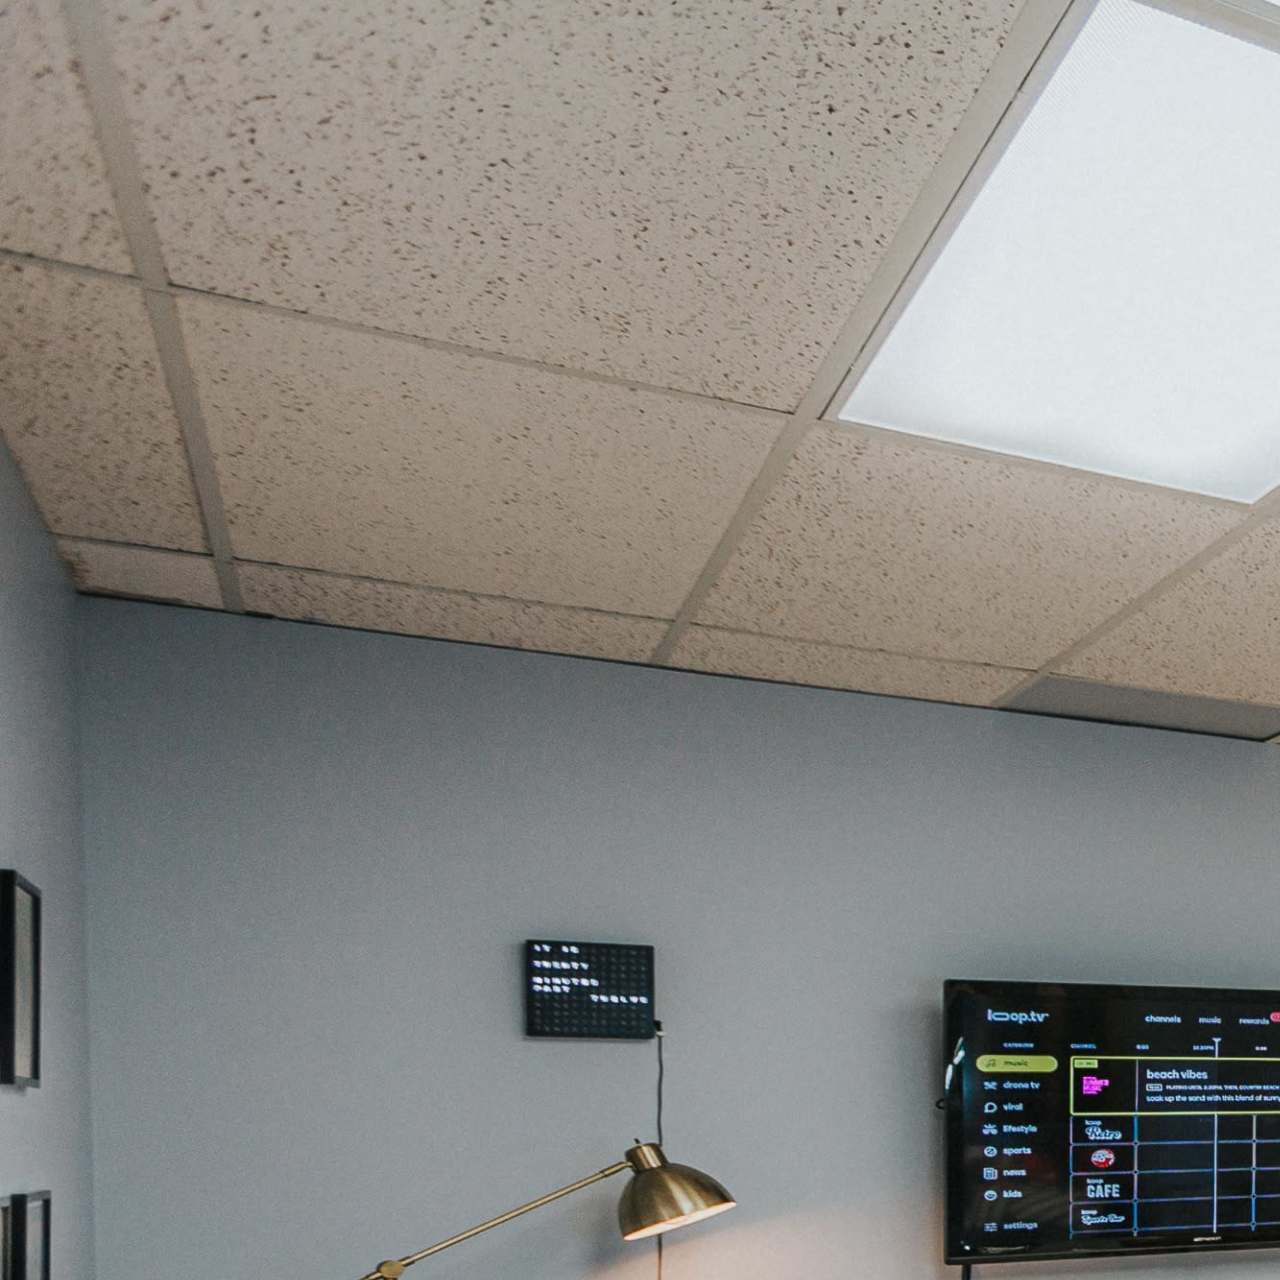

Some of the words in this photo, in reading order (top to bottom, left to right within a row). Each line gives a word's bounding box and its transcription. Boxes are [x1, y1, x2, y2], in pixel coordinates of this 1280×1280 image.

[1145, 1014, 1182, 1024] channels
[1199, 1016, 1221, 1024] music
[1146, 1069, 1179, 1080] beach
[1180, 1069, 1208, 1080] vibes
[1003, 1102, 1023, 1111] viral
[1003, 1125, 1038, 1134] lifestyle
[1085, 1126, 1122, 1140] Retro
[1003, 1147, 1032, 1156] sports
[1003, 1169, 1027, 1177] news
[1003, 1190, 1022, 1198] kids
[1087, 1184, 1120, 1198] CAFE
[1003, 1221, 1038, 1231] settings
